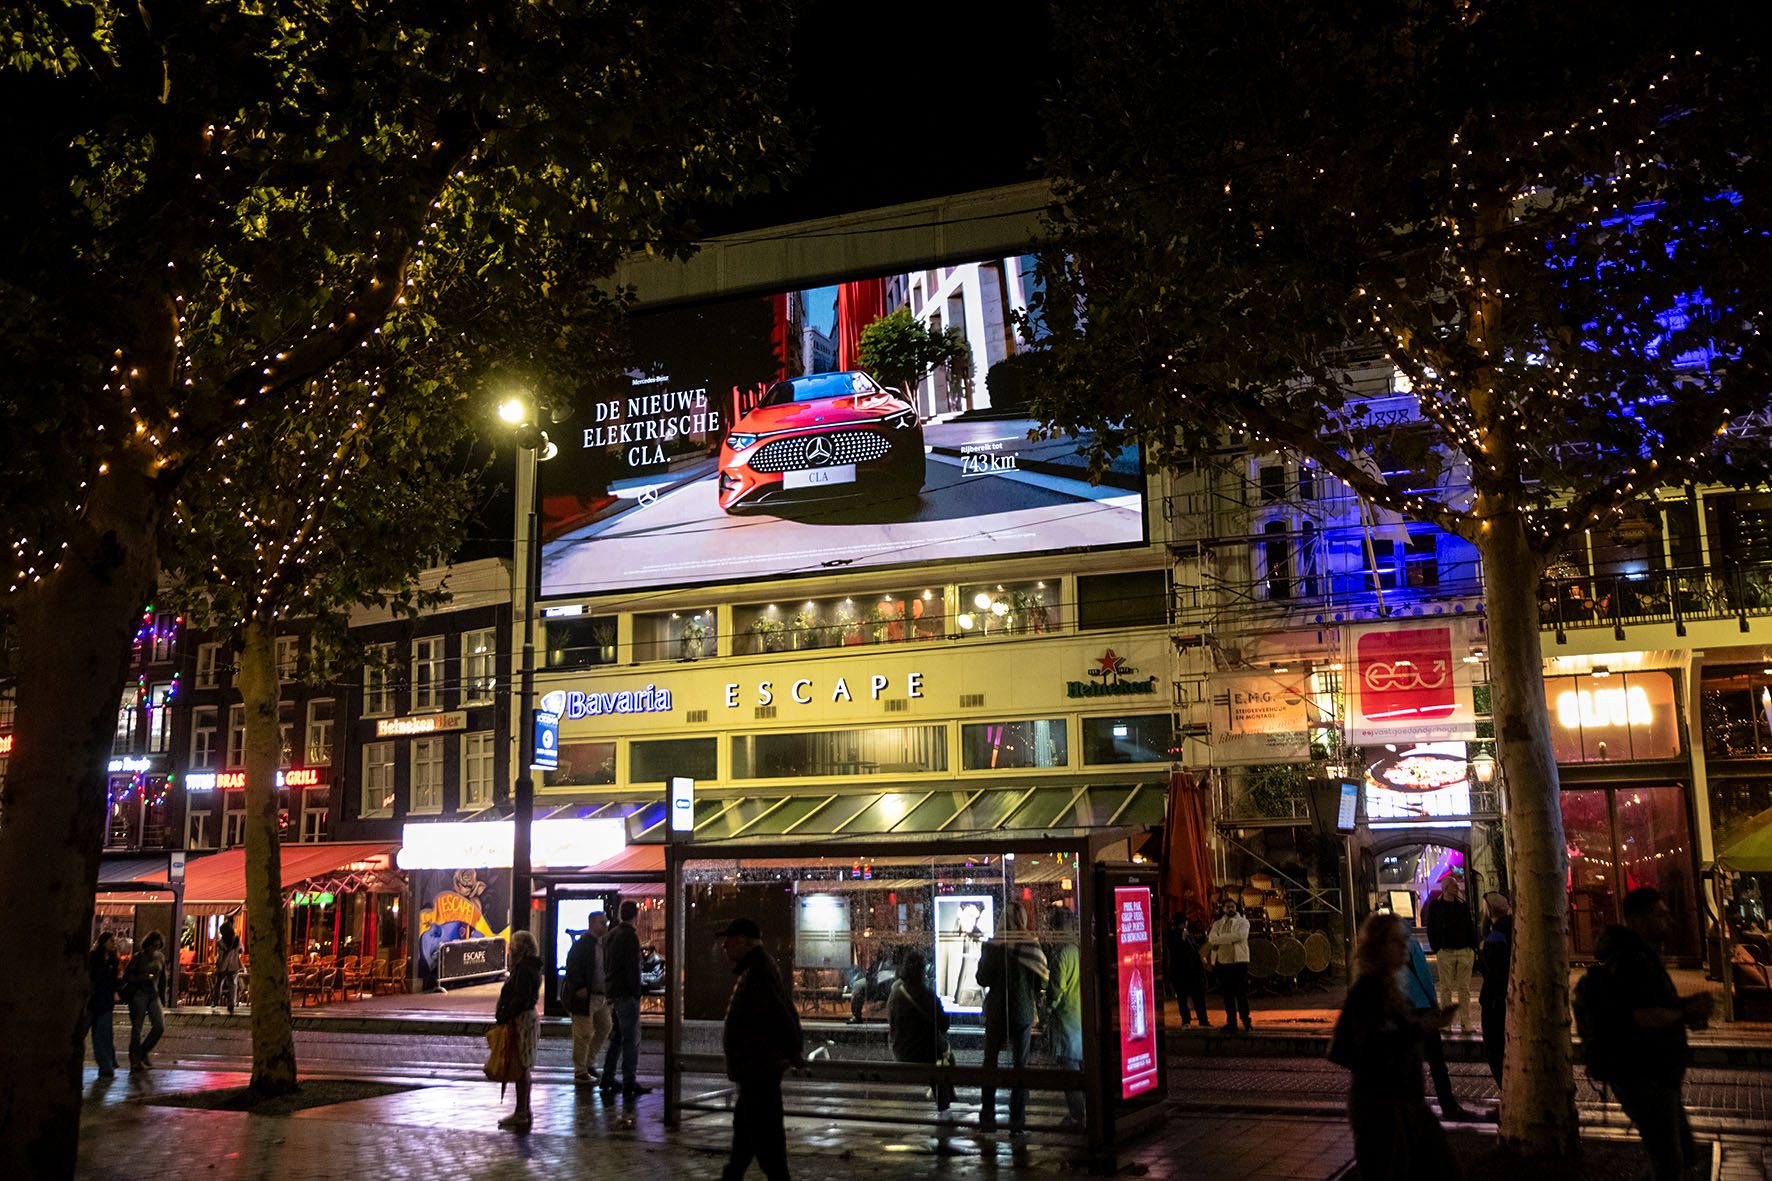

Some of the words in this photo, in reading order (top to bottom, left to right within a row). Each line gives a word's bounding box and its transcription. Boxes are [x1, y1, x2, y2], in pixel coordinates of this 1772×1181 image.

[632, 375, 669, 386] Mercedes-Benz
[595, 400, 621, 423] DE
[627, 388, 707, 418] NIEUWE
[582, 411, 720, 449] ELEKTRISCHE
[627, 444, 672, 467] CLA.
[960, 445, 992, 454] Rijbereik
[960, 454, 989, 474] 743
[808, 471, 829, 483] CLA
[724, 672, 925, 709] ESCAPE
[1066, 677, 1158, 698] Heineken
[567, 683, 673, 720] Bavaria
[1234, 691, 1276, 705] E.M.G.
[378, 717, 434, 737] Heineken
[286, 769, 319, 786] GRILL
[441, 894, 472, 916] ESCAPE
[463, 950, 487, 961] ESCAPE
